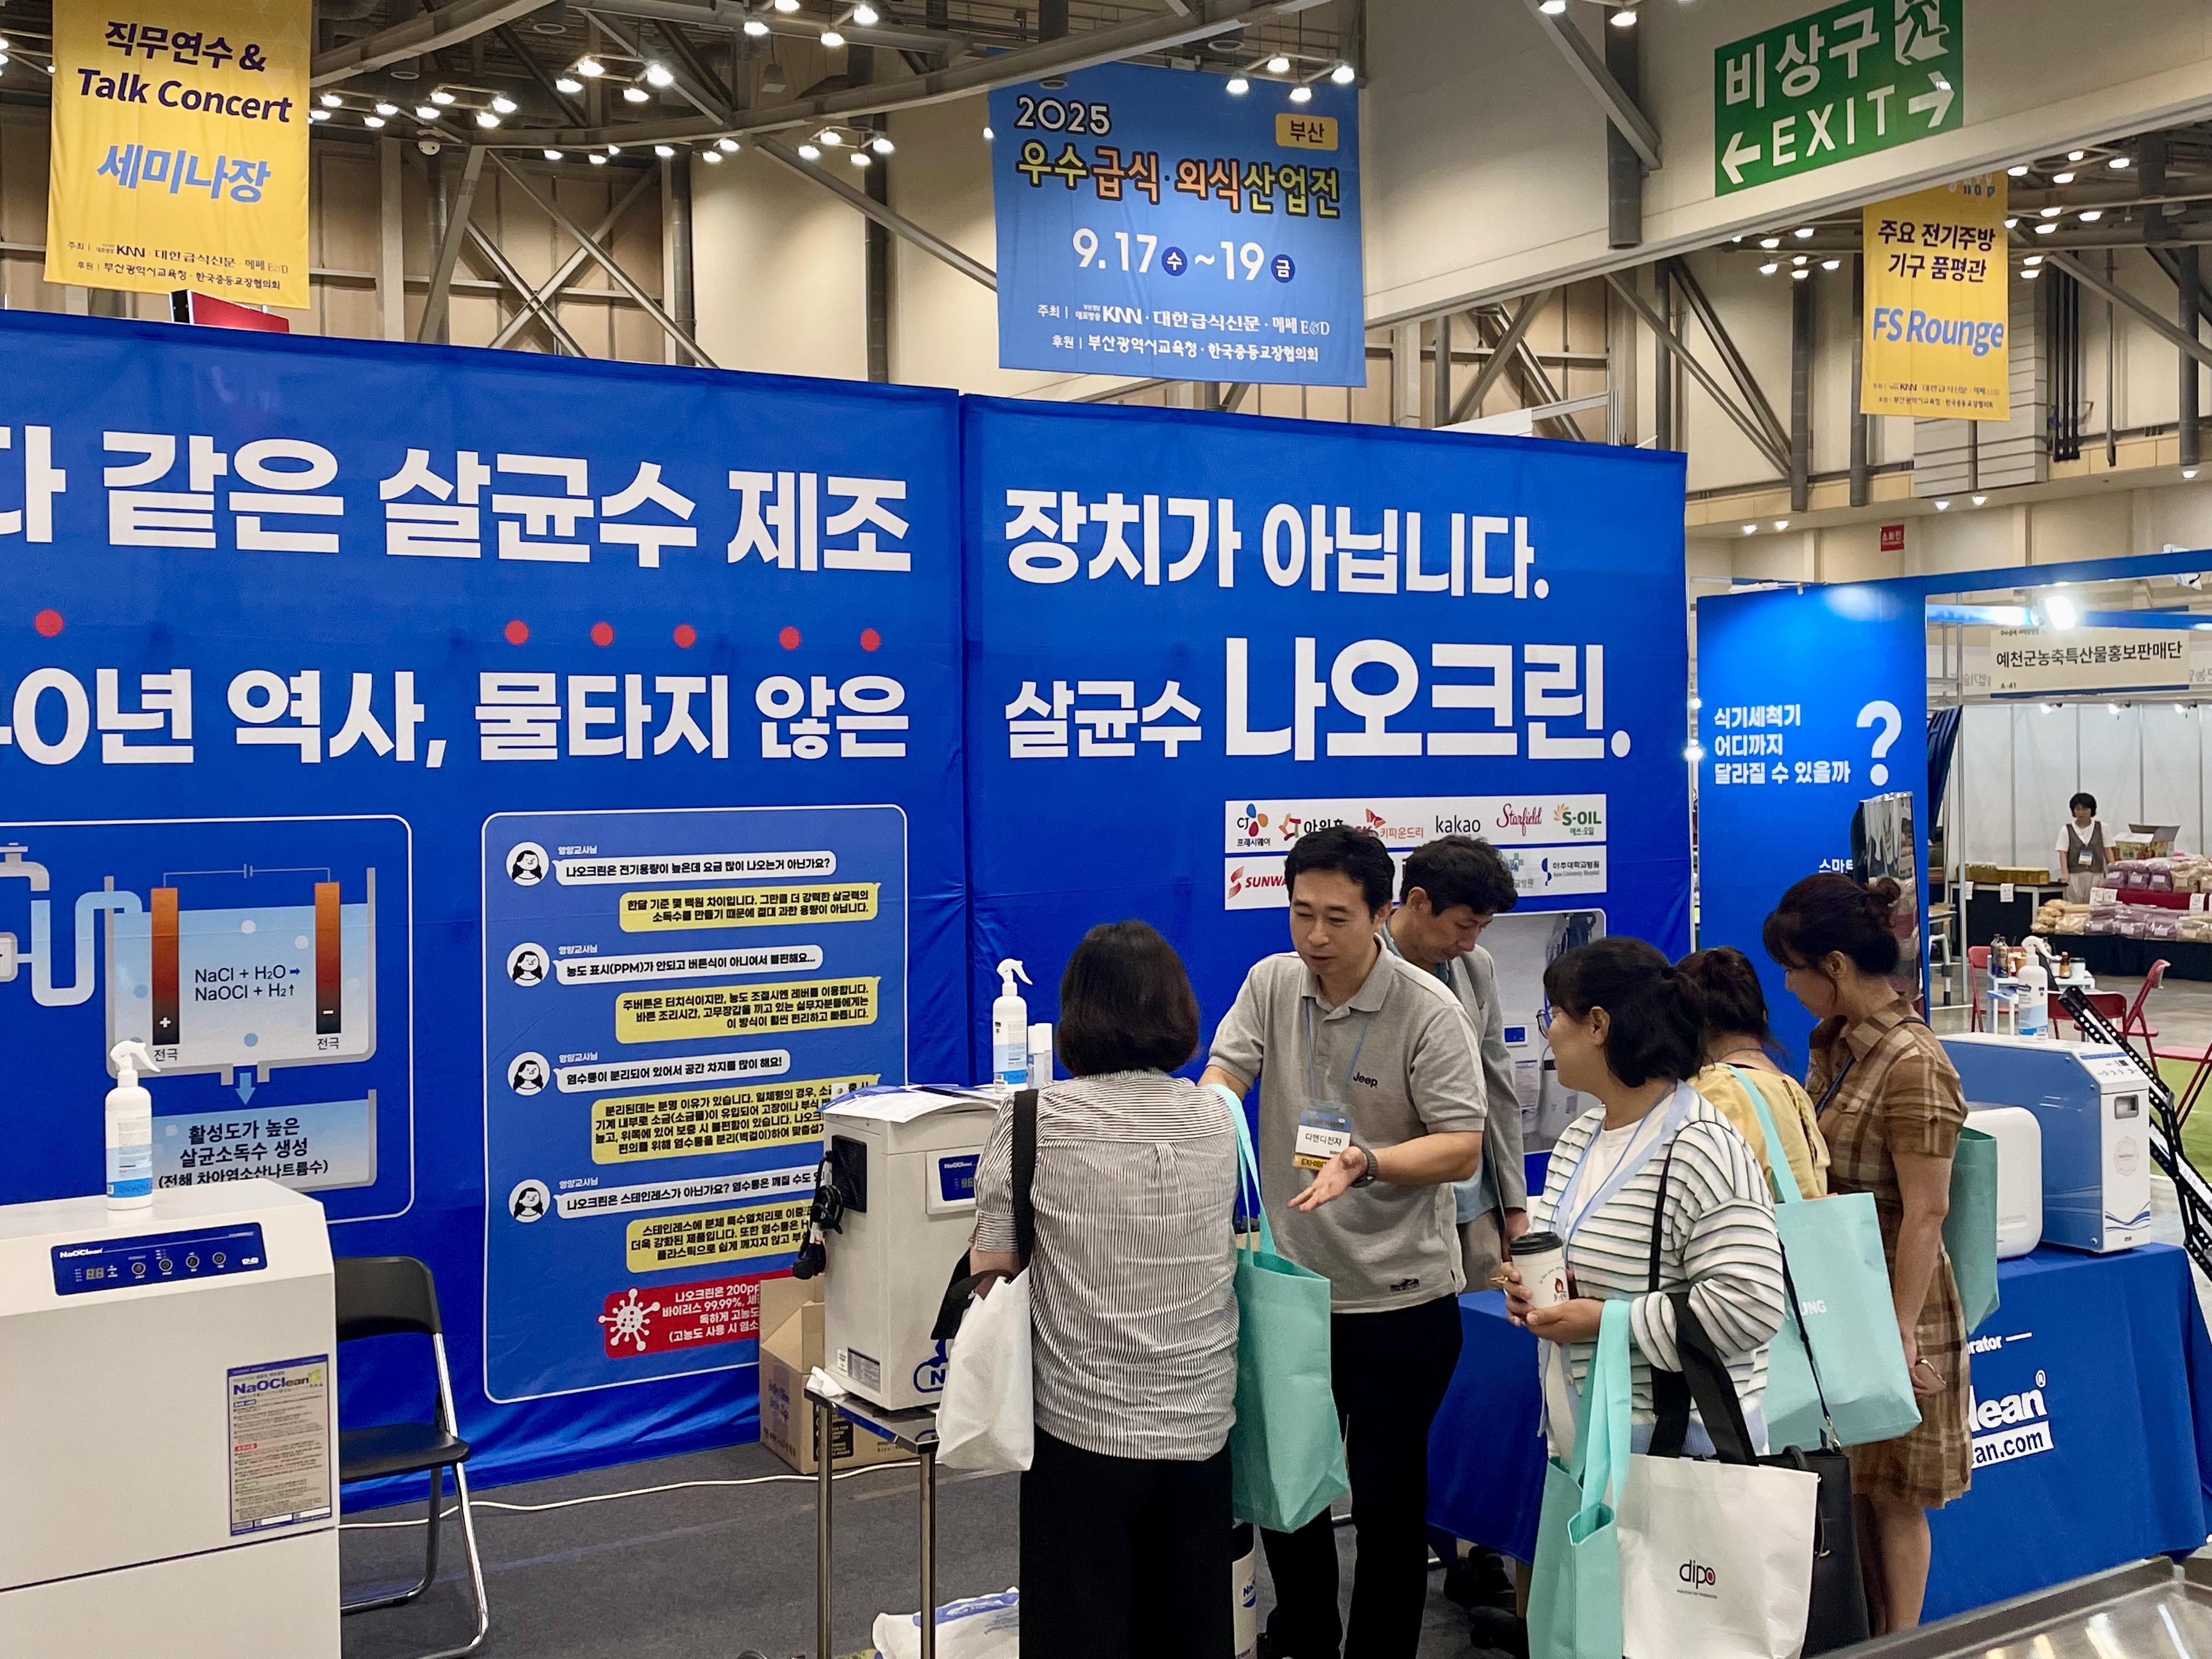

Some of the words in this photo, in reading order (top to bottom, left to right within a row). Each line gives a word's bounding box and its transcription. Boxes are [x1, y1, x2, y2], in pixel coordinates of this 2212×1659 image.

[105, 21, 233, 69] 직무연수
[239, 44, 267, 72] &
[1725, 7, 1880, 109] 비상구
[77, 68, 151, 104] Talk
[158, 80, 292, 122] Concert
[1015, 95, 1111, 135] 2025
[1773, 83, 1895, 167] EXIT
[1289, 120, 1325, 144] 부산
[97, 144, 271, 203] 세미나장
[1878, 220, 1915, 244] 주요
[1921, 224, 1995, 251] 전기주방
[116, 244, 145, 258] KNN
[1073, 228, 1158, 274] 9.17
[1888, 253, 1925, 278] 기구
[1931, 256, 1986, 283] 품평관
[1037, 304, 1060, 319] 주최
[1103, 306, 1142, 325] KNN
[1153, 311, 1260, 332] 대한급식신문
[1874, 308, 1904, 341] FS
[1906, 310, 2004, 357] Rounge
[1052, 335, 1074, 349] 후원
[1088, 335, 1197, 357] 부산광역시교육청
[1207, 342, 1319, 363] 한국중등교장협의회
[103, 431, 344, 553] 같은
[379, 448, 697, 568] 살균수
[727, 470, 911, 572] 제조
[1006, 489, 1242, 588] 장치가
[1262, 503, 1549, 600] 아닙니다.
[1996, 640, 2182, 668] 예천군농축특산물홍보판매단
[1005, 680, 1203, 758] 살균수
[1226, 636, 1631, 761] 나오크린.
[0, 668, 194, 765] 0년
[227, 669, 447, 768] 역사,
[475, 672, 729, 761] 물타지
[755, 675, 909, 760] 않은
[1714, 704, 1801, 729] 식기세척기
[1714, 763, 1765, 785] 달라질
[1771, 762, 1789, 785] 수
[1795, 760, 1851, 784] 있을까
[1856, 700, 1902, 786] ?
[1714, 733, 1783, 757] 어디까지
[1237, 817, 1249, 830] CJ
[1436, 815, 1480, 833] kakao
[1497, 803, 1542, 837] Starfield
[1562, 811, 1602, 826] S-OIL
[1380, 827, 1423, 839] 키파운드리
[566, 864, 617, 877] 나오크린은
[619, 864, 669, 876] 전기용량이
[703, 861, 723, 872] 요금
[747, 860, 785, 871] 나오는거
[787, 858, 830, 870] 아닌가요?
[707, 895, 758, 907] 차이입니다.
[830, 902, 868, 914] 아닙니다.
[195, 968, 234, 984] NaCl
[195, 985, 248, 1001] NaOCl
[154, 1048, 178, 1062] 전극
[317, 1037, 339, 1050] 전극
[685, 1063, 704, 1074] 공간
[1353, 1072, 1378, 1088] Jeep
[189, 1120, 259, 1145] 활성도가
[266, 1117, 300, 1138] 높은
[180, 1142, 268, 1168] 살균소독수
[274, 1137, 307, 1159] 생성
[234, 1377, 309, 1395] NaOClean
[1679, 1559, 1716, 1589] dipo
